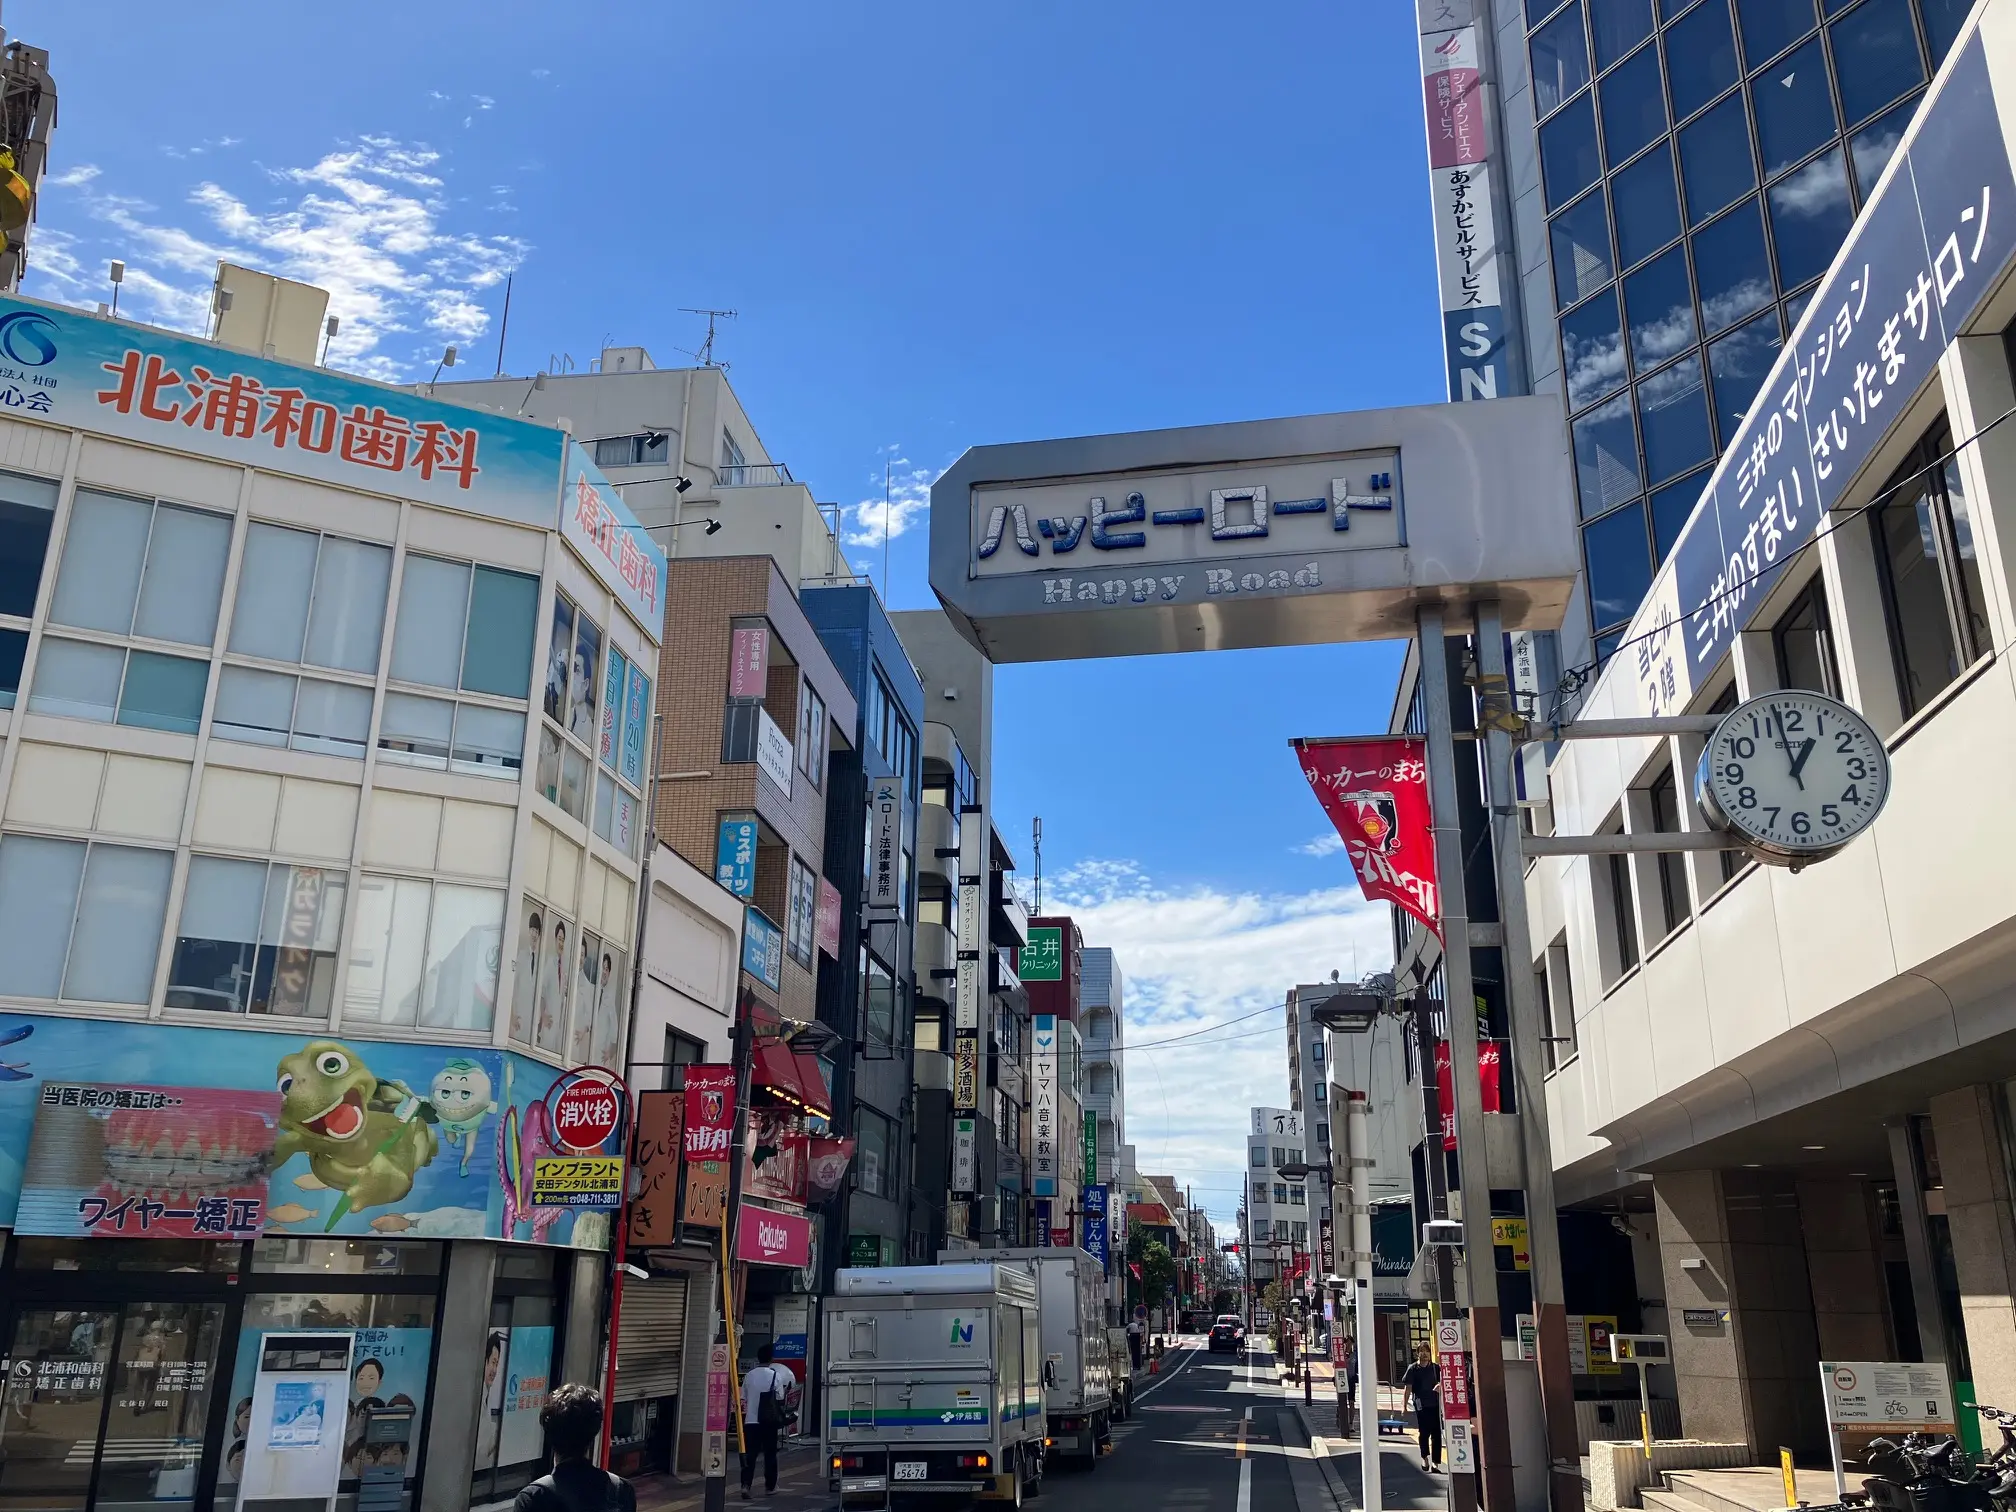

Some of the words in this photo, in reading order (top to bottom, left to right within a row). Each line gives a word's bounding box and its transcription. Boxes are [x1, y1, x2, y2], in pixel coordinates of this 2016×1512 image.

[1434, 0, 1456, 21] ス
[1437, 76, 1454, 140] 保険サービス
[1453, 72, 1472, 160] ジェイアンドエス
[1449, 169, 1483, 306] あすかビルサービス
[0, 367, 28, 382] 法人
[1735, 262, 1871, 511] 三井のマンション
[97, 349, 481, 490] 北浦和歯科
[1696, 466, 1803, 664] 三井のすまい
[1812, 184, 1992, 481] さいたまサロン
[978, 470, 1393, 560] ハッピーロード
[574, 471, 657, 615] 矯正歯科
[1041, 571, 1186, 605] Happy
[1204, 561, 1323, 596] Road
[749, 631, 762, 671] 女性専用
[1637, 600, 1674, 682] 当ビル
[735, 631, 746, 695] フィットネスクラブ
[1517, 636, 1533, 708] 人材派遣・
[599, 654, 618, 759] 土日診療
[625, 673, 644, 778] 平日20時
[1753, 716, 1773, 738] 11
[1817, 714, 1824, 736] 1
[1730, 736, 1756, 759] 10
[1774, 740, 1806, 749] SEIK
[1835, 731, 1855, 754] 2
[1305, 758, 1426, 790] サッカーのまち
[1725, 763, 1744, 785] 9
[1846, 757, 1867, 781] 3
[1738, 786, 1758, 809] 8
[1840, 783, 1862, 806] 4
[1762, 806, 1781, 829] 7
[1791, 811, 1811, 835] 6
[1821, 804, 1841, 827] 5
[734, 825, 752, 891] eスポーツ
[877, 803, 892, 897] ロード法律事務所
[1021, 938, 1059, 956] 石井
[1021, 959, 1059, 970] クリニック
[684, 1075, 736, 1091] サッカーのまち
[957, 1040, 974, 1102] 博多酒場
[566, 1089, 580, 1097] FIRE
[581, 1087, 608, 1096] HYDRANT
[560, 1098, 613, 1128] 消火栓
[1037, 1061, 1051, 1173] ヤマハ音楽教室
[1273, 1115, 1304, 1136] 万寿
[685, 1126, 732, 1152] 浦和
[537, 1162, 620, 1177] インプラント
[535, 1179, 618, 1190] 安田デンタル北浦和
[576, 1193, 617, 1204] 048-711-3811
[633, 1139, 666, 1238] ひびき
[79, 1197, 260, 1233] ワイヤー矯正
[759, 1221, 788, 1250] Rakuten
[1322, 1226, 1332, 1268] 美容室
[38, 1361, 105, 1375] 北浦和歯科
[1441, 1354, 1454, 1404] 禁止区域
[1453, 1354, 1467, 1404] 路上喫煙
[35, 1377, 102, 1390] 矯正歯科
[901, 1469, 925, 1478] 56-76
